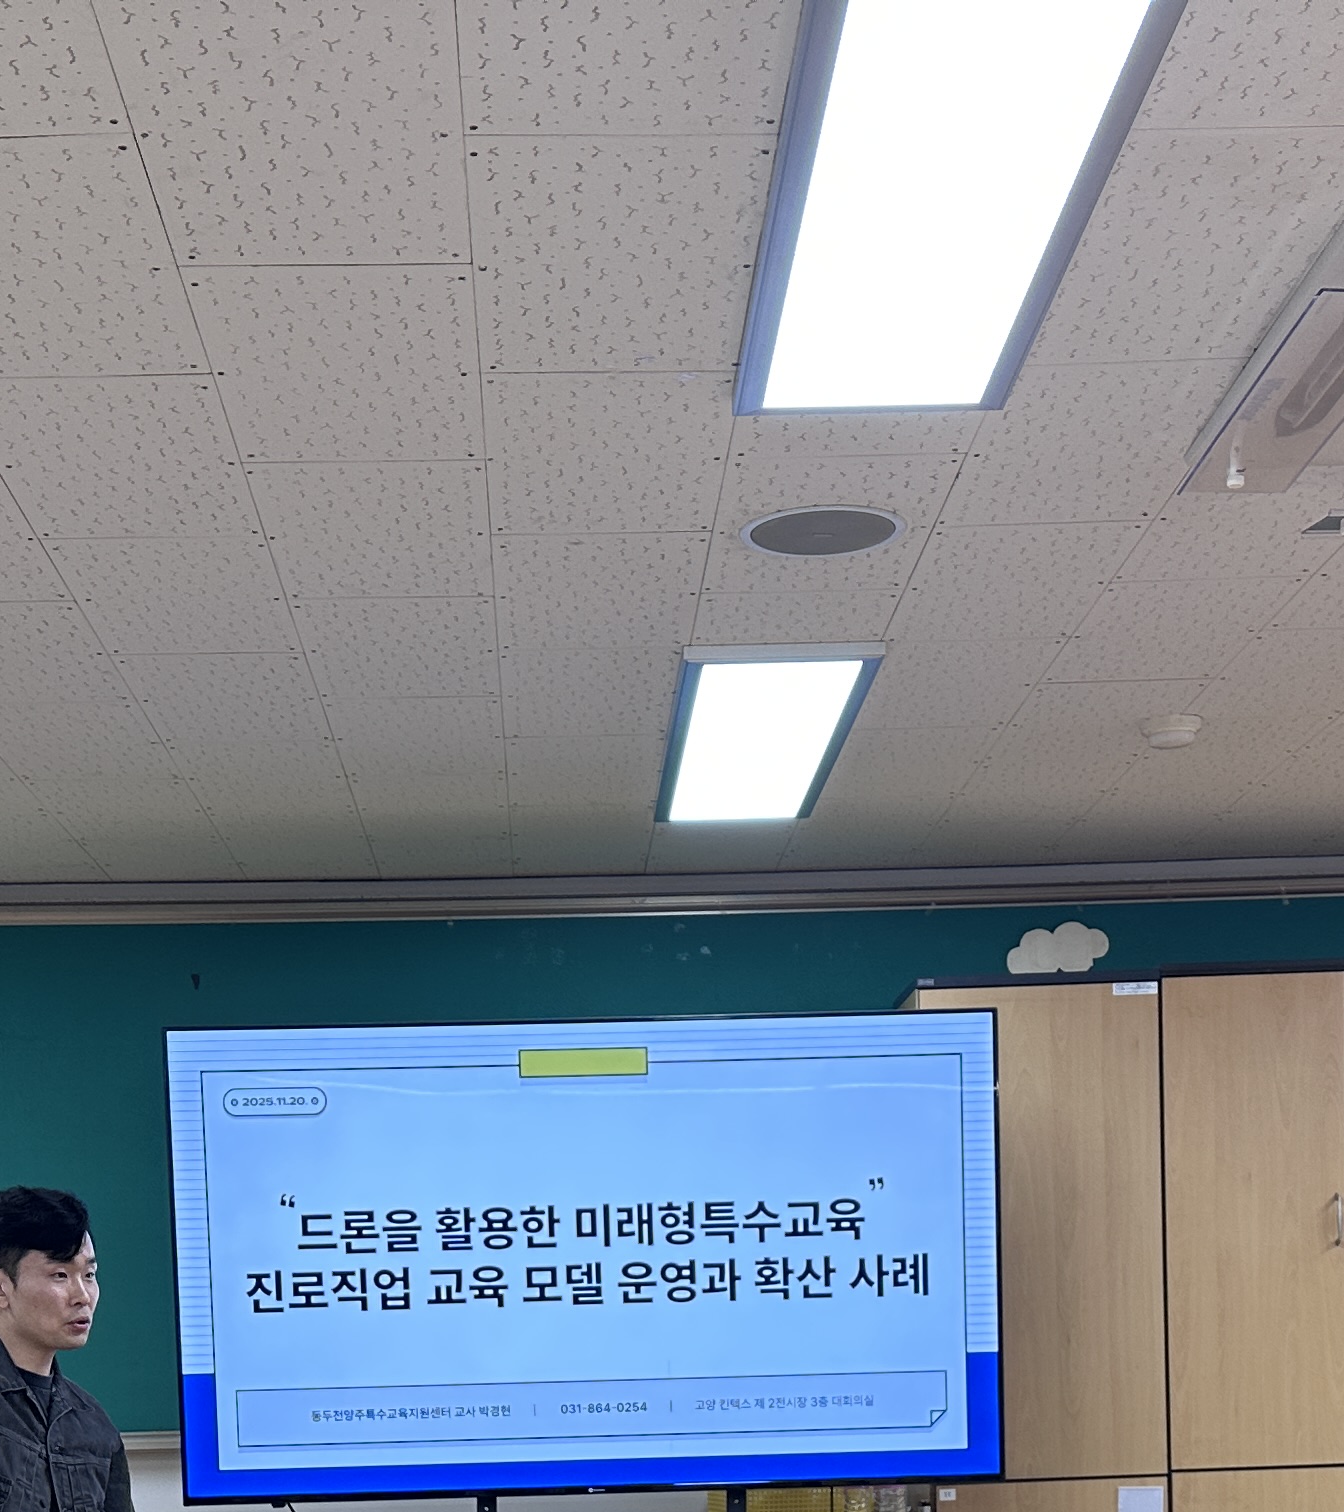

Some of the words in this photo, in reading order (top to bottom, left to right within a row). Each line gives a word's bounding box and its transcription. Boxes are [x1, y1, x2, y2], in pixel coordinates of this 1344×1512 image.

[435, 1204, 561, 1252] 활용한
[246, 1266, 411, 1313] 진로직업
[426, 1265, 509, 1308] 교육
[522, 1261, 605, 1306] 모델
[617, 1257, 742, 1304] 운영과
[754, 1254, 837, 1300] 확산
[849, 1252, 930, 1298] 사례
[454, 1405, 476, 1418] 교사
[560, 1401, 648, 1415] 031-864-0254
[695, 1398, 716, 1411] 고양
[719, 1397, 752, 1411] 킨텍스
[754, 1397, 765, 1410] 제
[768, 1396, 807, 1410] 2전시장
[810, 1395, 829, 1408] 3층
[831, 1393, 875, 1407] 대회의실
